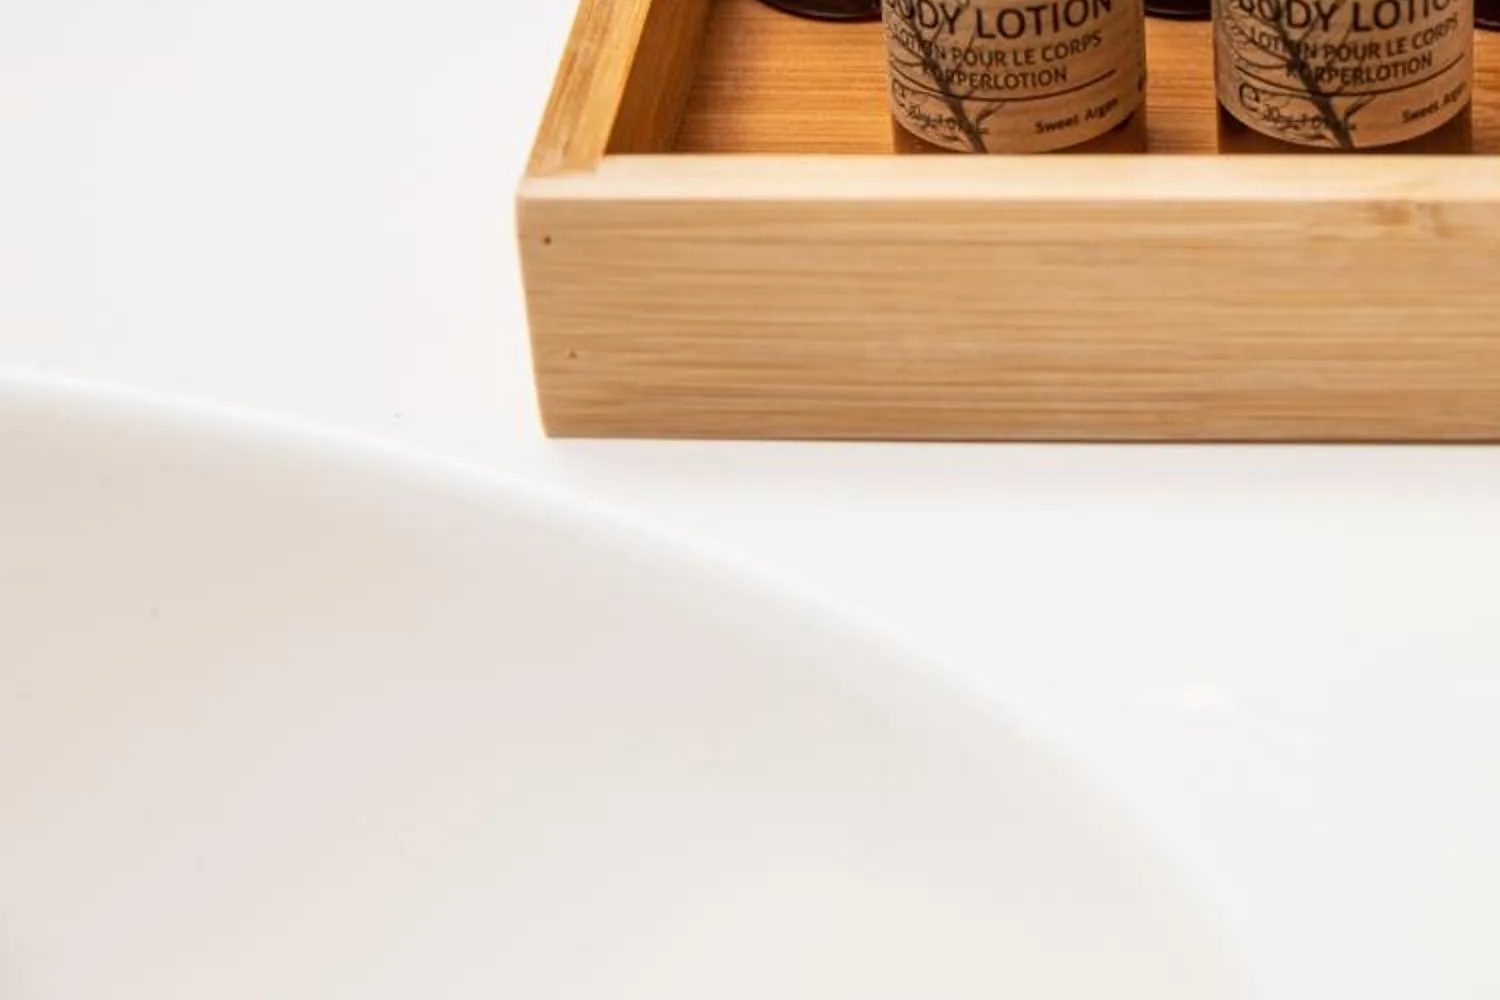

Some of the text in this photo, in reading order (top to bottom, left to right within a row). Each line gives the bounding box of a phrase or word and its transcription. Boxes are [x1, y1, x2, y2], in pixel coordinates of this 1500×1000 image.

[951, 47, 1008, 68] POUR
[1012, 47, 1036, 67] LE
[1041, 31, 1102, 62] CORPS
[1323, 40, 1381, 61] POUR
[1386, 36, 1409, 57] LE
